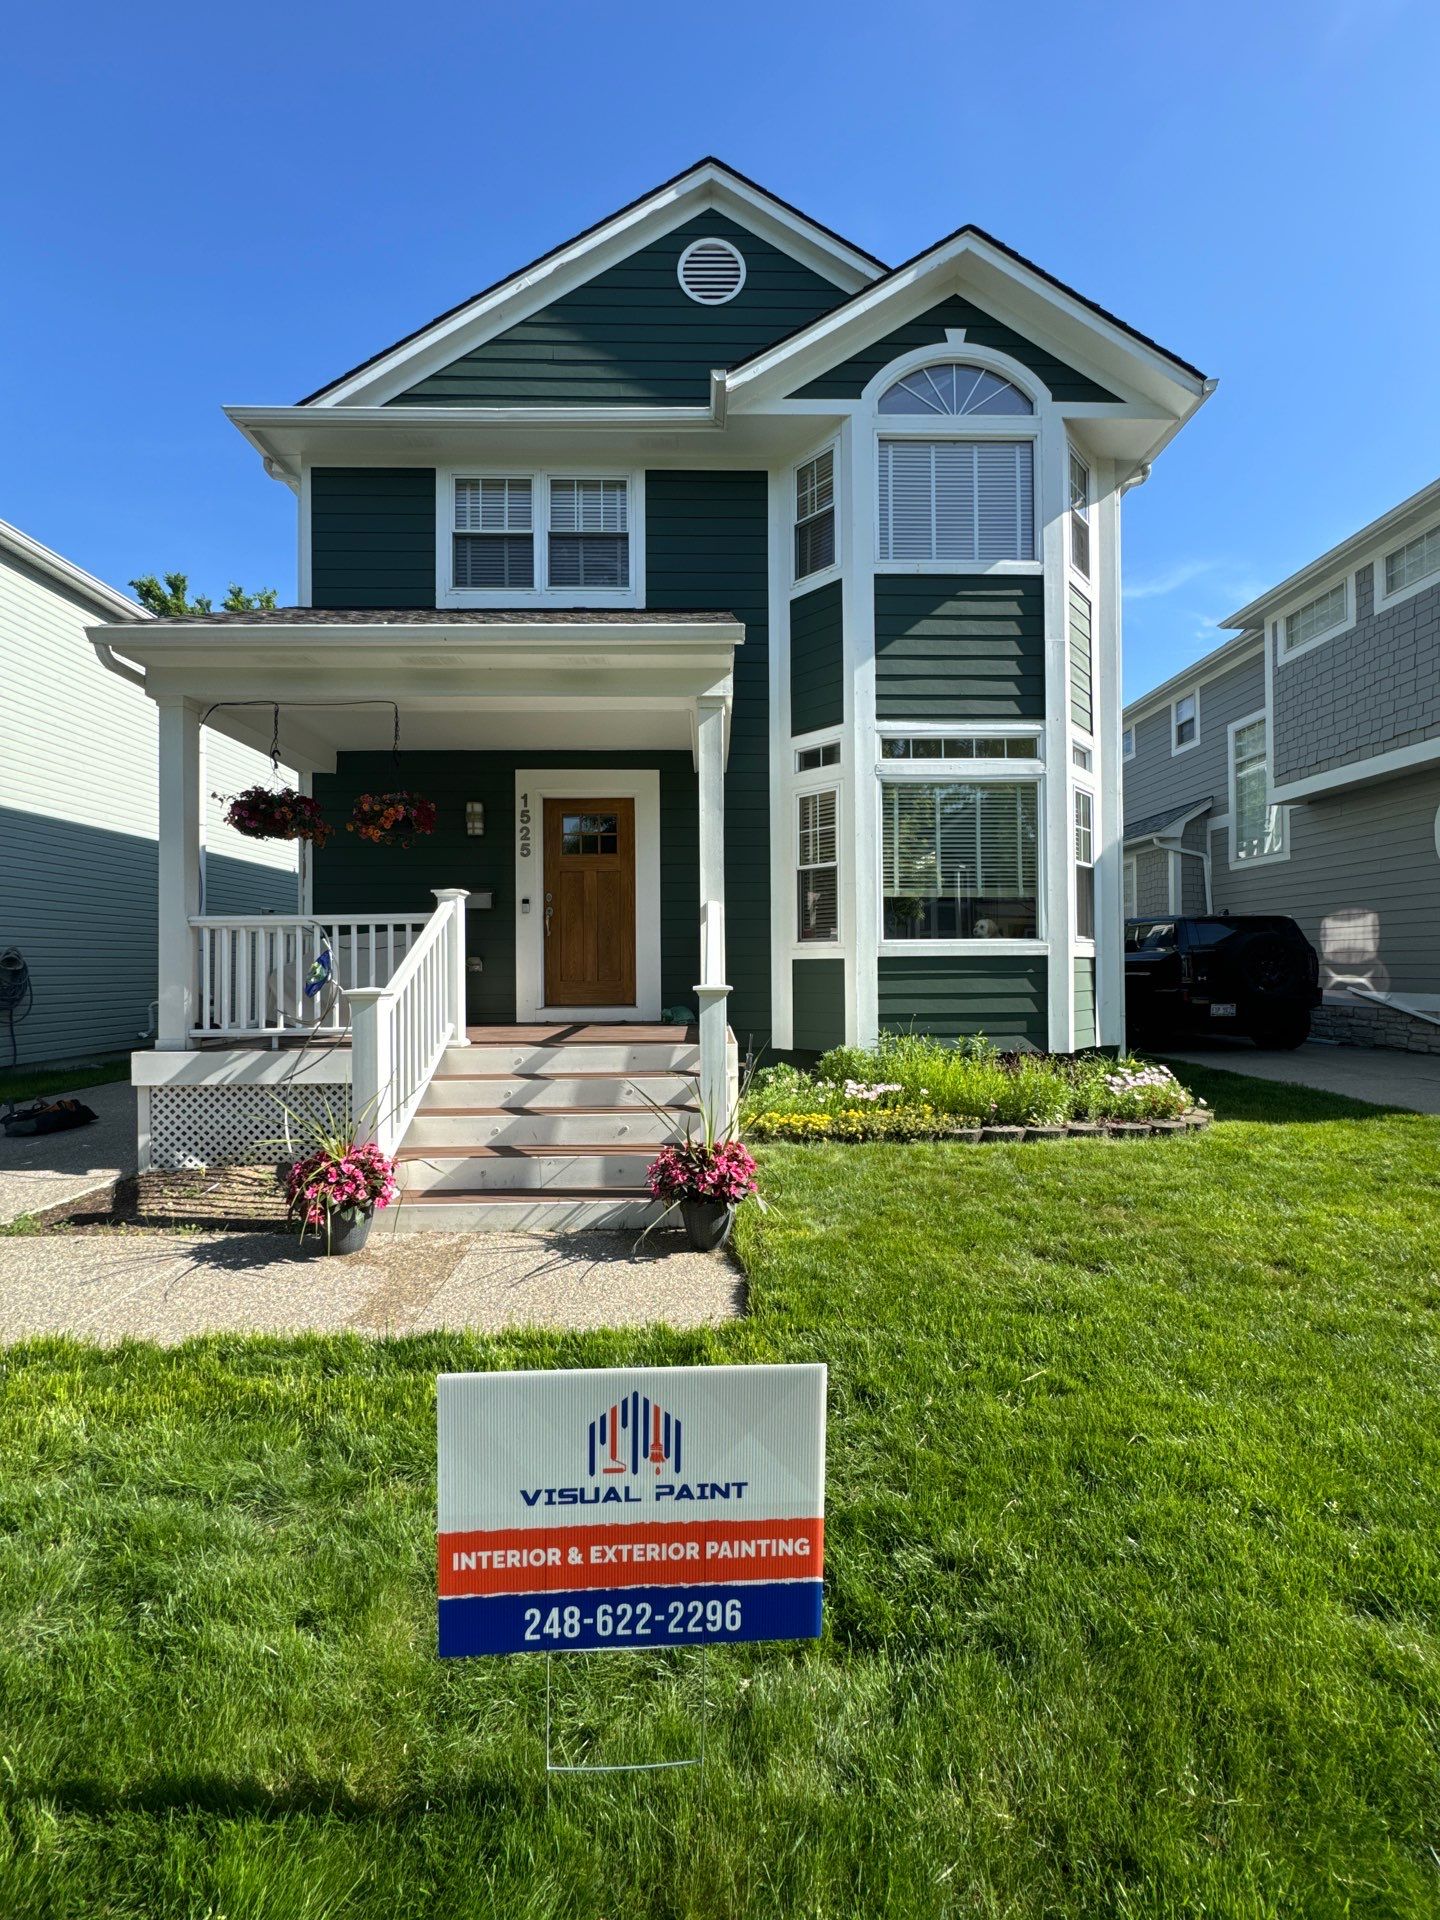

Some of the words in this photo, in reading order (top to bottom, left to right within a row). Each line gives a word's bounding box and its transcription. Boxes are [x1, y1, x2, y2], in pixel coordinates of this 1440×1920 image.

[519, 793, 531, 858] 1525
[520, 1486, 641, 1506] VISUAL
[655, 1482, 749, 1502] PAINT
[452, 1548, 561, 1571] INTERIOR
[567, 1548, 584, 1565] &
[589, 1541, 699, 1564] EXTERIOR
[705, 1537, 810, 1560] PAINTING
[523, 1599, 742, 1641] 248-622-2296
